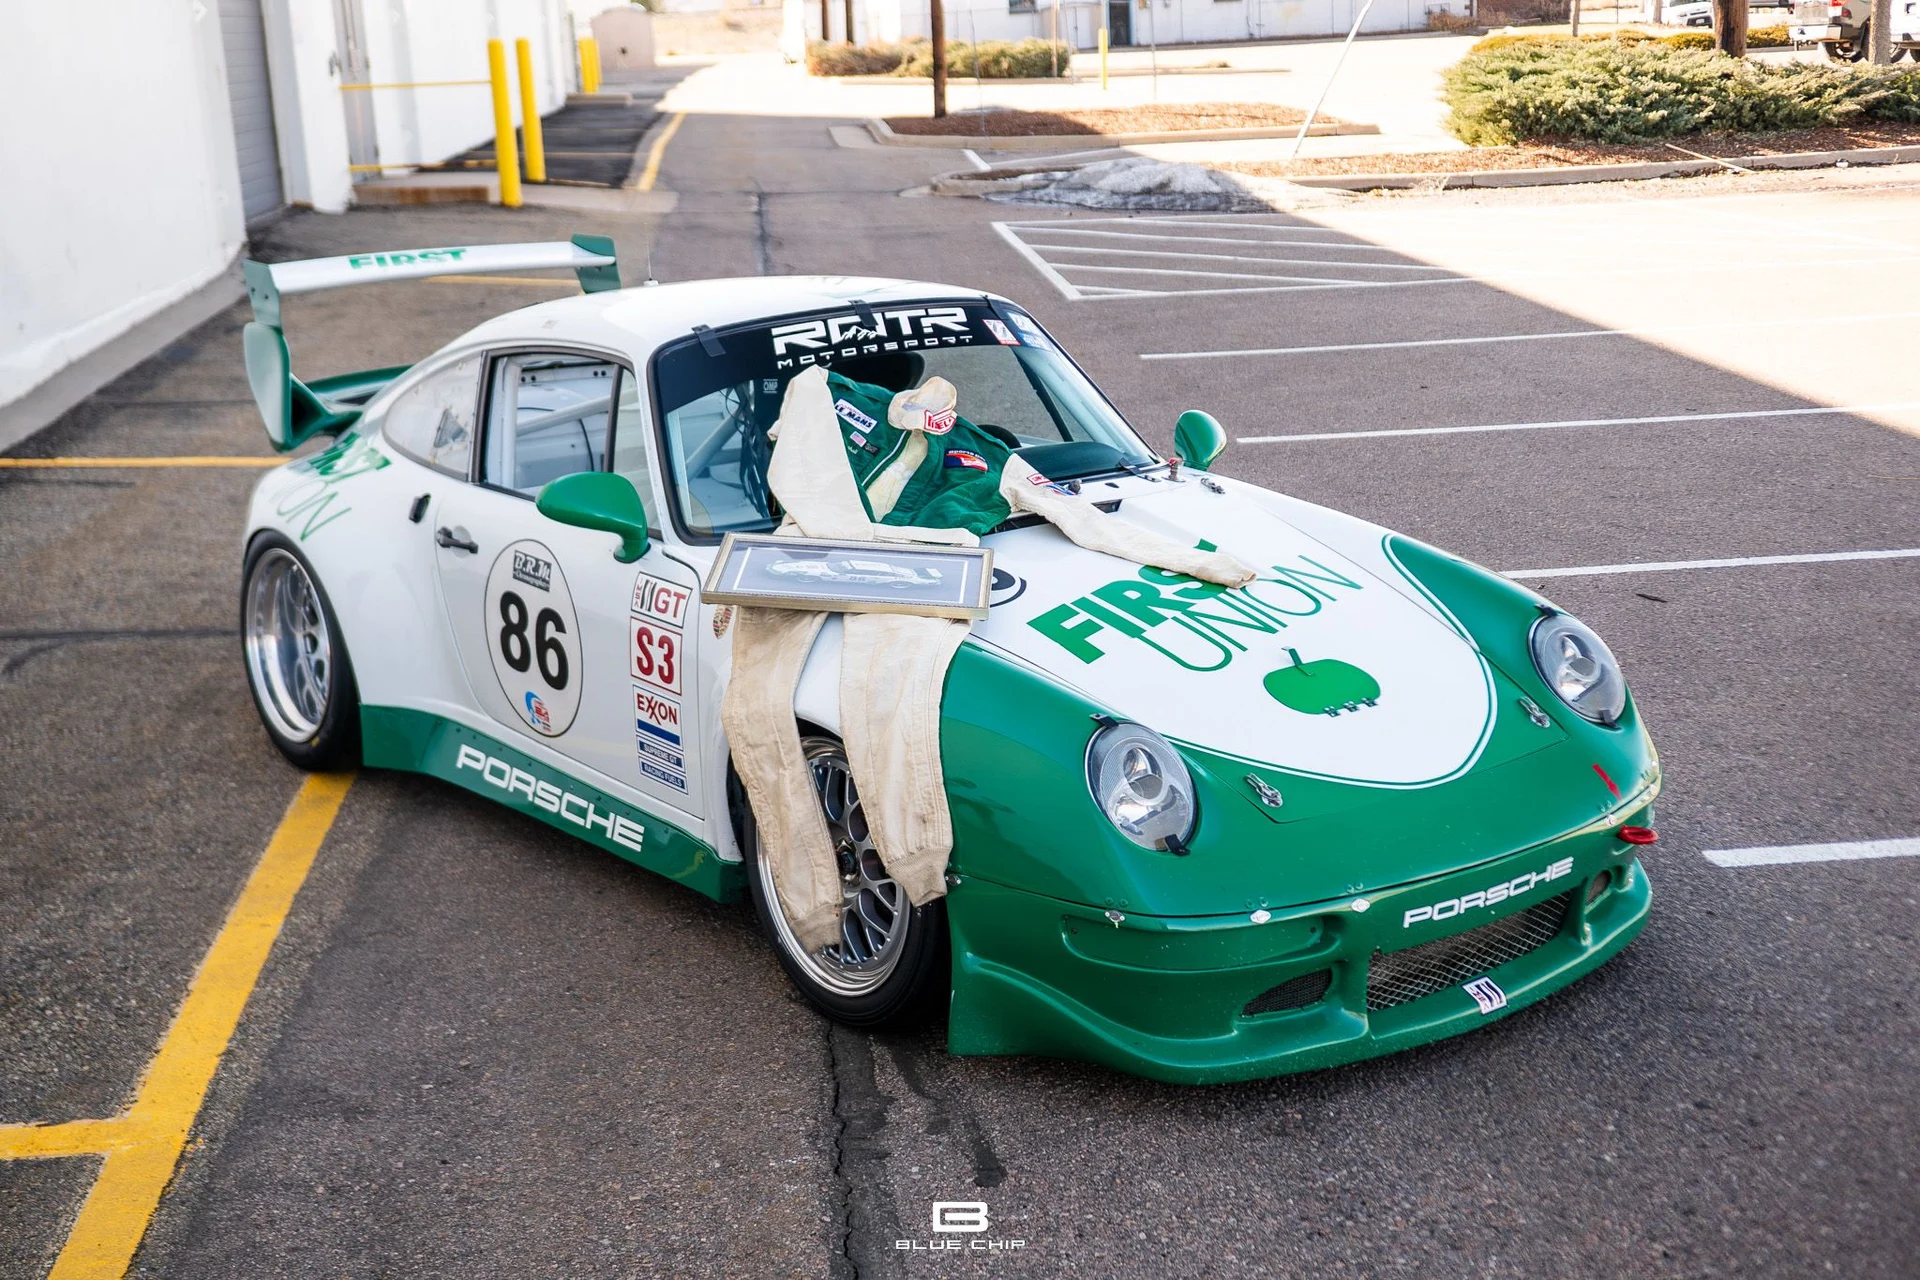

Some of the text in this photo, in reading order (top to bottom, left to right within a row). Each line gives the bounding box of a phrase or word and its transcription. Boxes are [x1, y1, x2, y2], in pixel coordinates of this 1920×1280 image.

[348, 248, 467, 269] FIRST
[777, 335, 973, 370] MOTORSPORT
[763, 380, 778, 392] OMP
[834, 404, 845, 413] LE
[846, 411, 873, 428] MANS
[654, 587, 687, 618] GT
[1134, 555, 1364, 672] UNION
[500, 590, 569, 691] 86
[636, 626, 675, 684] S3
[636, 693, 678, 725] EXXON
[643, 743, 677, 764] SUPREME GT
[643, 763, 683, 786] RACING FUELS
[456, 744, 644, 852] PORSCHE
[1403, 856, 1574, 928] PORSCHE
